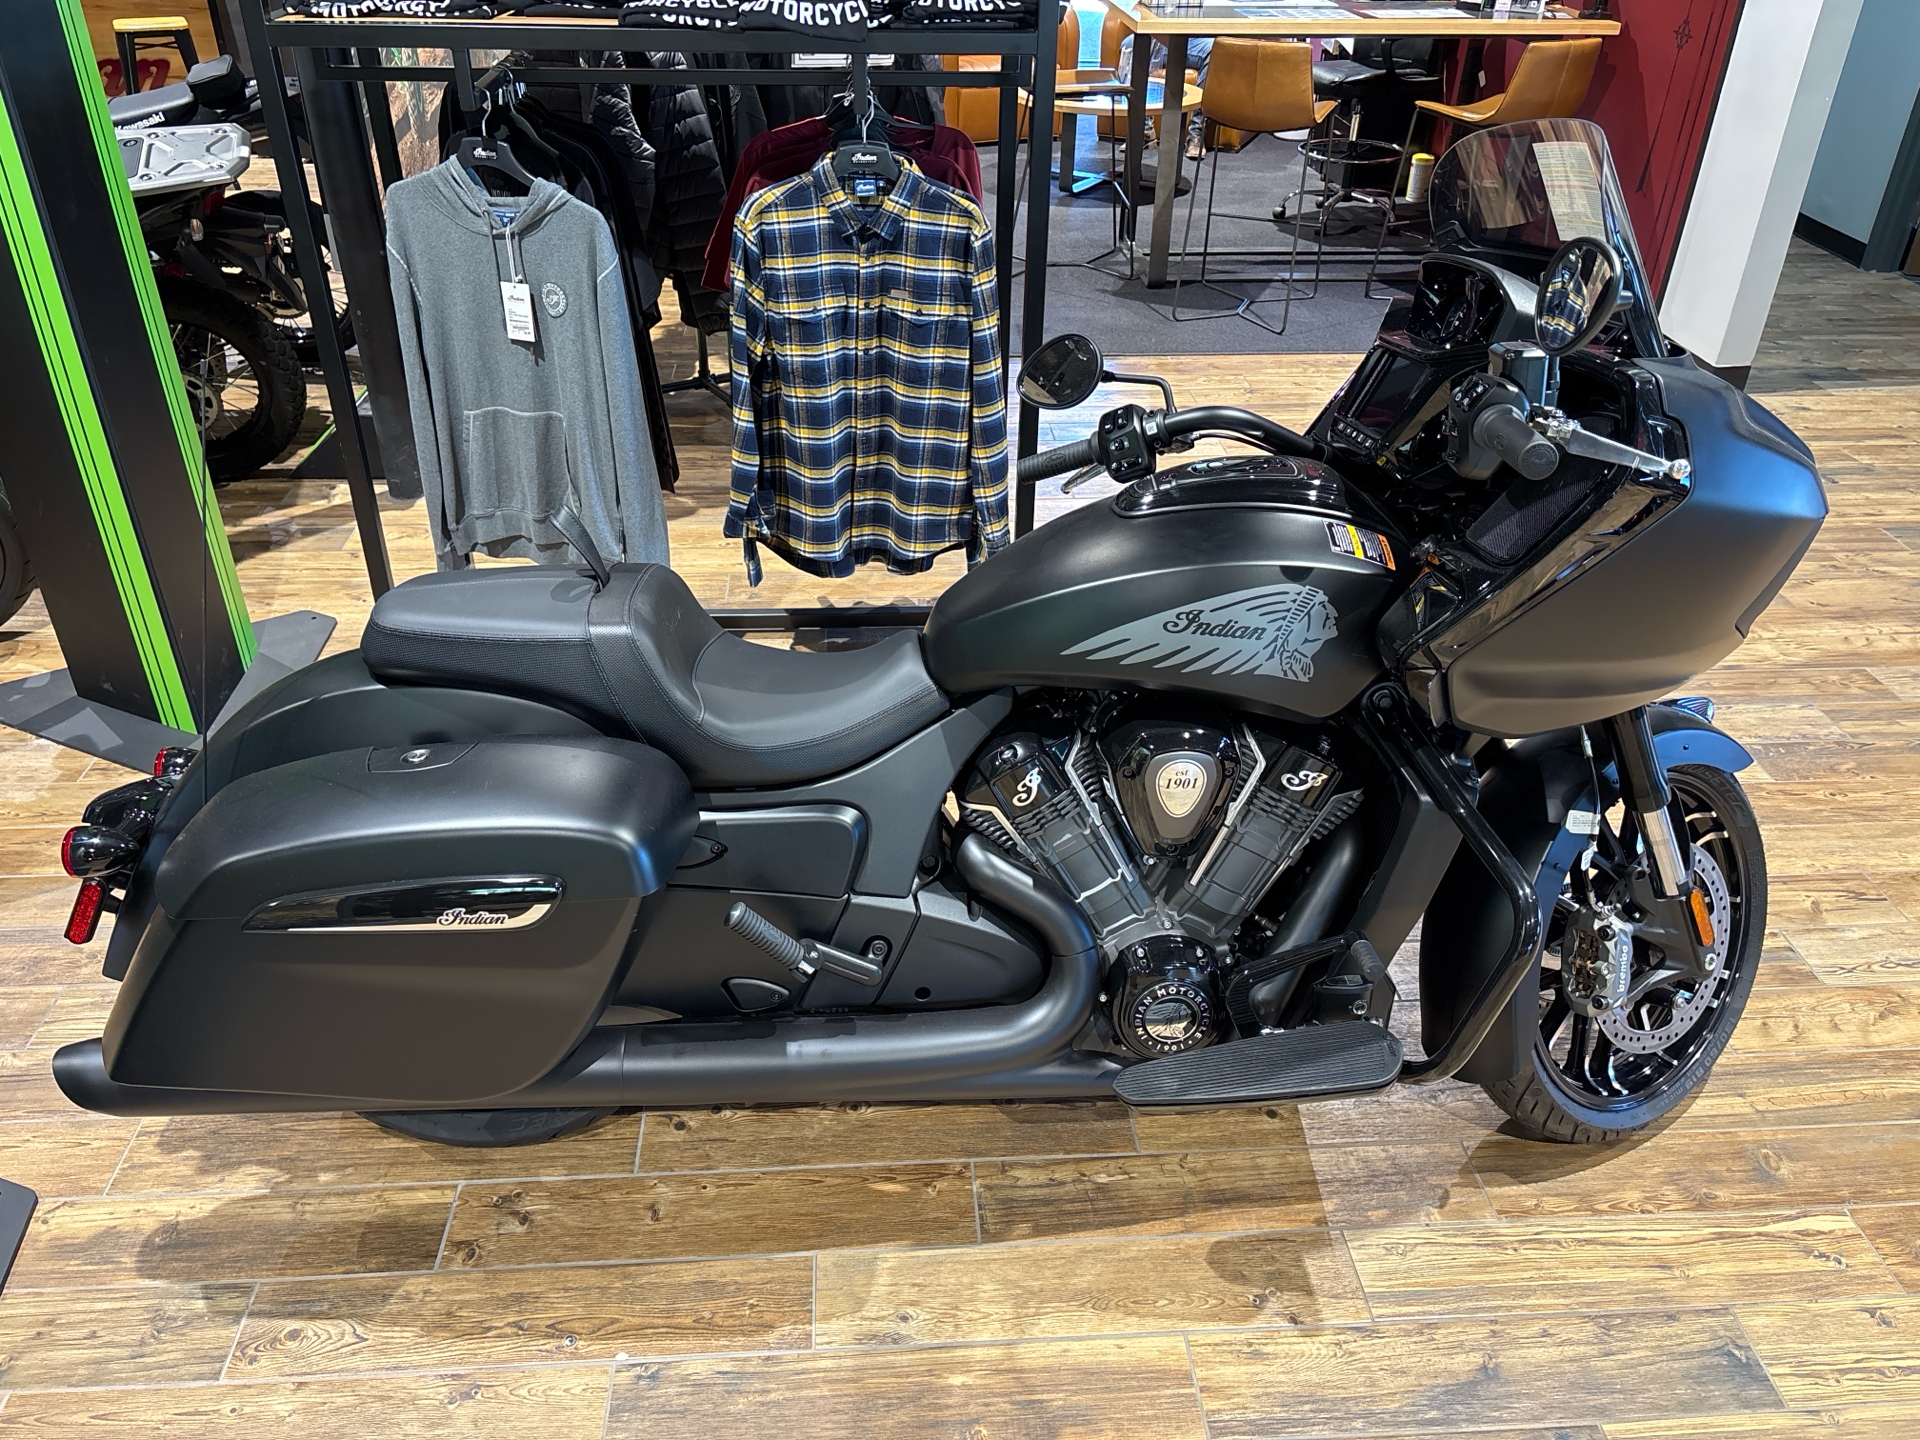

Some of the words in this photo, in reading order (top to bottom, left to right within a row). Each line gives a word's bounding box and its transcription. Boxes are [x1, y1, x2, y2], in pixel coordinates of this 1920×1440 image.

[851, 152, 877, 161] Indian
[1162, 609, 1267, 641] Indian
[1165, 777, 1199, 790] 1901
[437, 908, 508, 926] Indian
[1617, 945, 1629, 992] brembo
[1134, 997, 1154, 1040] INDIAN
[1156, 987, 1210, 1039] MOTORCYCLE
